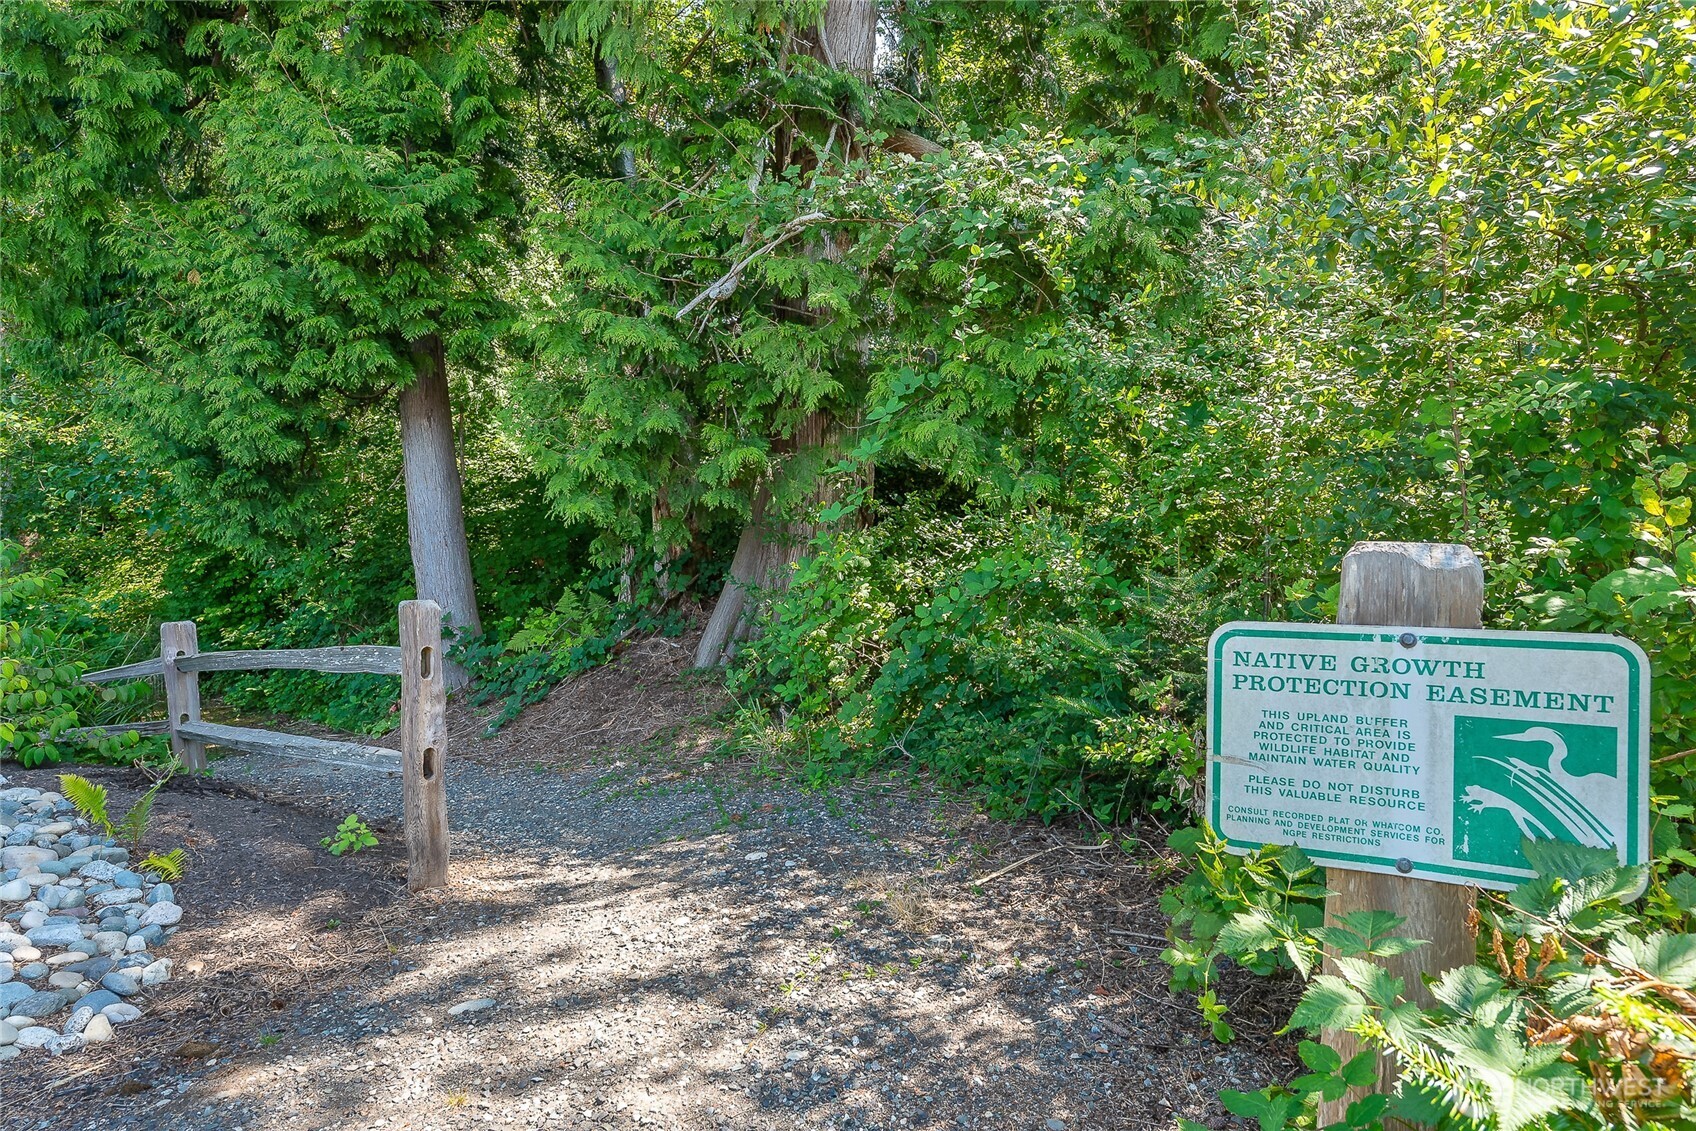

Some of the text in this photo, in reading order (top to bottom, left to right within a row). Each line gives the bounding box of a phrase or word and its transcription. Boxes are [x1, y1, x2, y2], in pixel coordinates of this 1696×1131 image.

[1233, 652, 1485, 679] NATIVE GROWTH
[1232, 674, 1614, 713] PROTECTION EASEMENT
[1259, 721, 1410, 739] AND CRITICAL AREA IS
[1262, 710, 1408, 728] THIS UPLAND BUFFER
[1254, 731, 1415, 751] PROTECTED TO PROVIDE
[1259, 742, 1410, 762] WILDLIFE HABITAT AND
[1249, 752, 1420, 775] MAINTAIN WATER QUALITY
[1244, 785, 1425, 811] THIS VALUABLE RESOURCE
[1249, 775, 1419, 798] PLEASE DO NOT DISTURB
[1227, 814, 1270, 825] PLANNING
[1298, 822, 1365, 835] DEVELOPMENT
[1370, 830, 1419, 842] SERVICES
[1425, 836, 1445, 845] FOR
[1228, 806, 1268, 816] CONSULT
[1273, 810, 1323, 822] RECORDED
[1329, 816, 1350, 824] PLAT
[1372, 821, 1420, 832] WHATCOM
[1426, 827, 1443, 836] CO.
[1283, 829, 1380, 846] NGPE RESTRICTIONS
